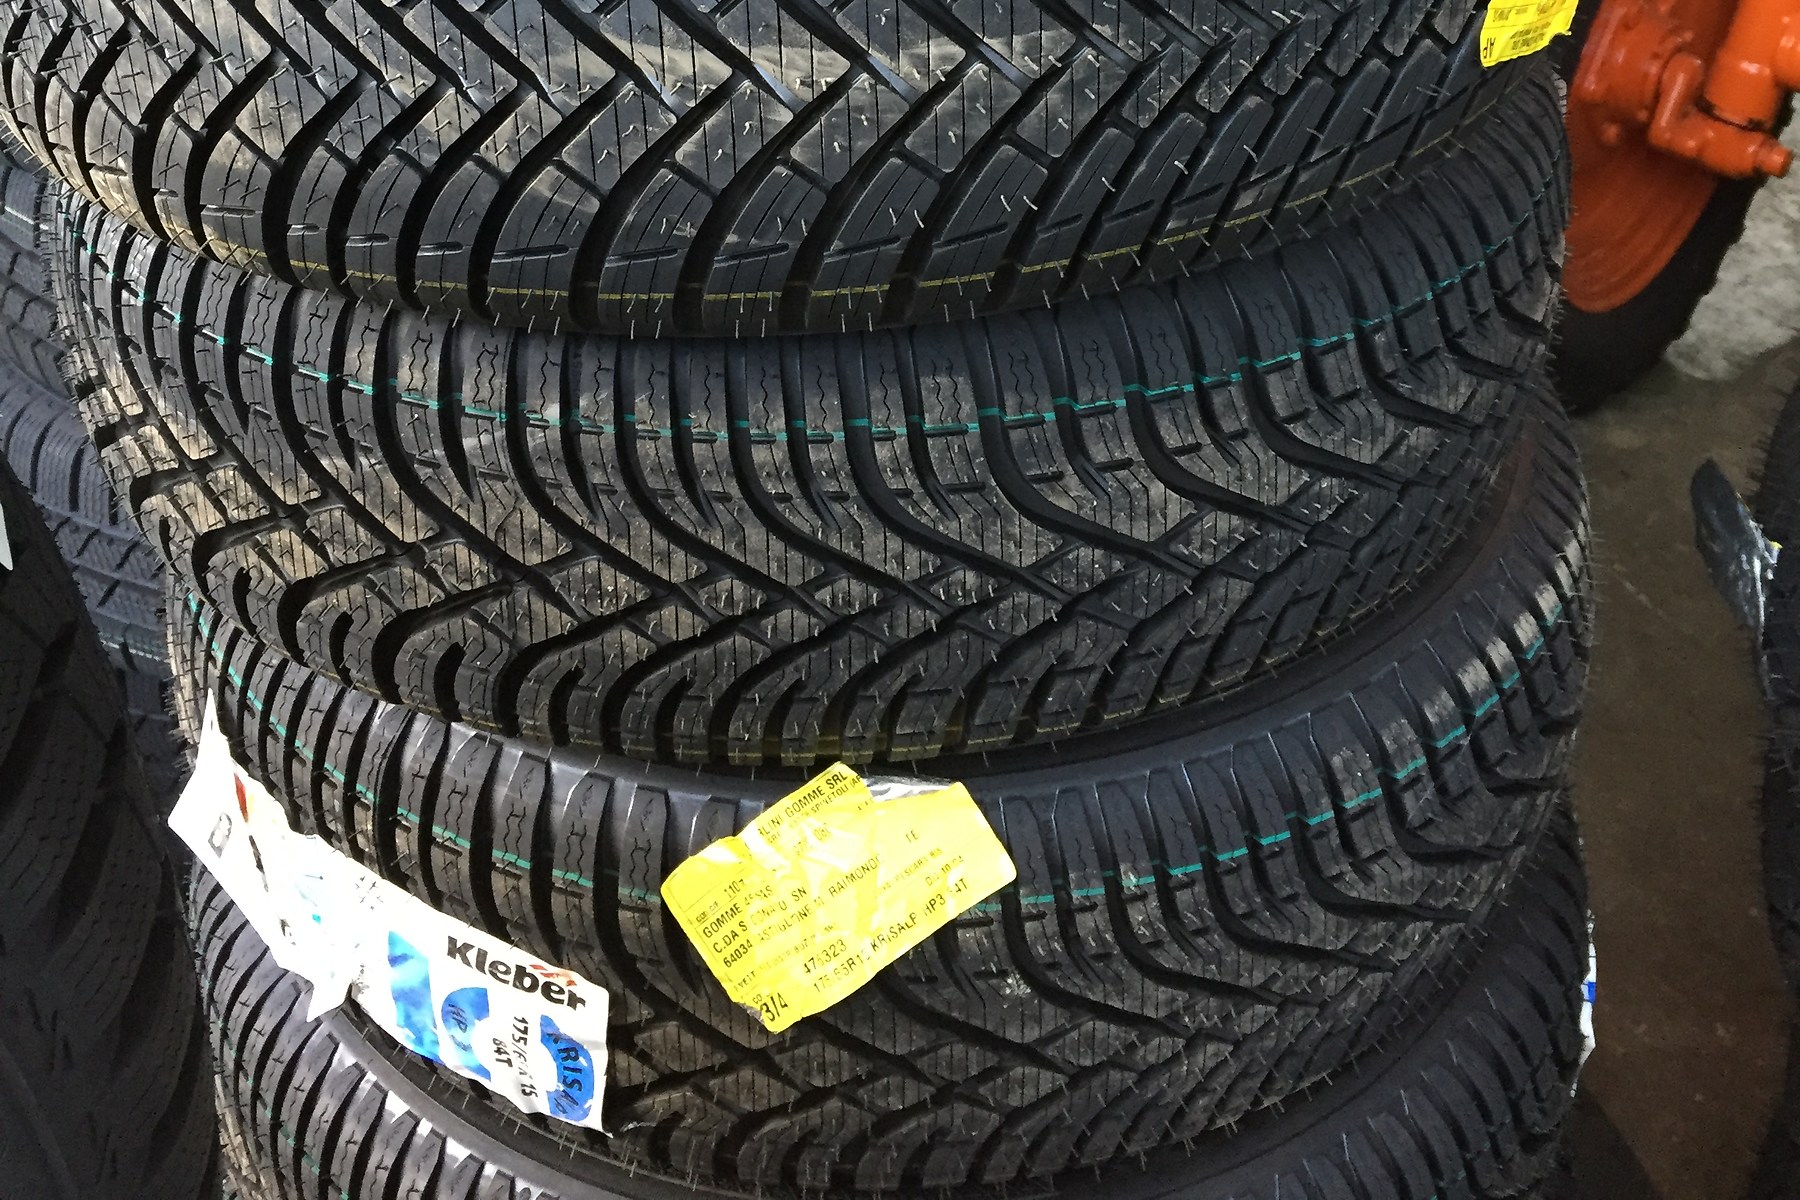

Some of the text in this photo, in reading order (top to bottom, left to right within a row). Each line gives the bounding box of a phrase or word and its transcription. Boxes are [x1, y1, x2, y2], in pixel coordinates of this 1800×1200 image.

[784, 784, 826, 818] GOMME
[824, 770, 848, 790] SRL
[702, 902, 743, 939] GOMME
[869, 911, 917, 952] KRISALP
[923, 892, 946, 917] HP3
[712, 929, 740, 954] C.DA
[722, 938, 753, 968] 64034
[446, 935, 587, 1011] Kleber
[758, 992, 789, 1023] 3/4
[490, 1036, 513, 1071] 84T
